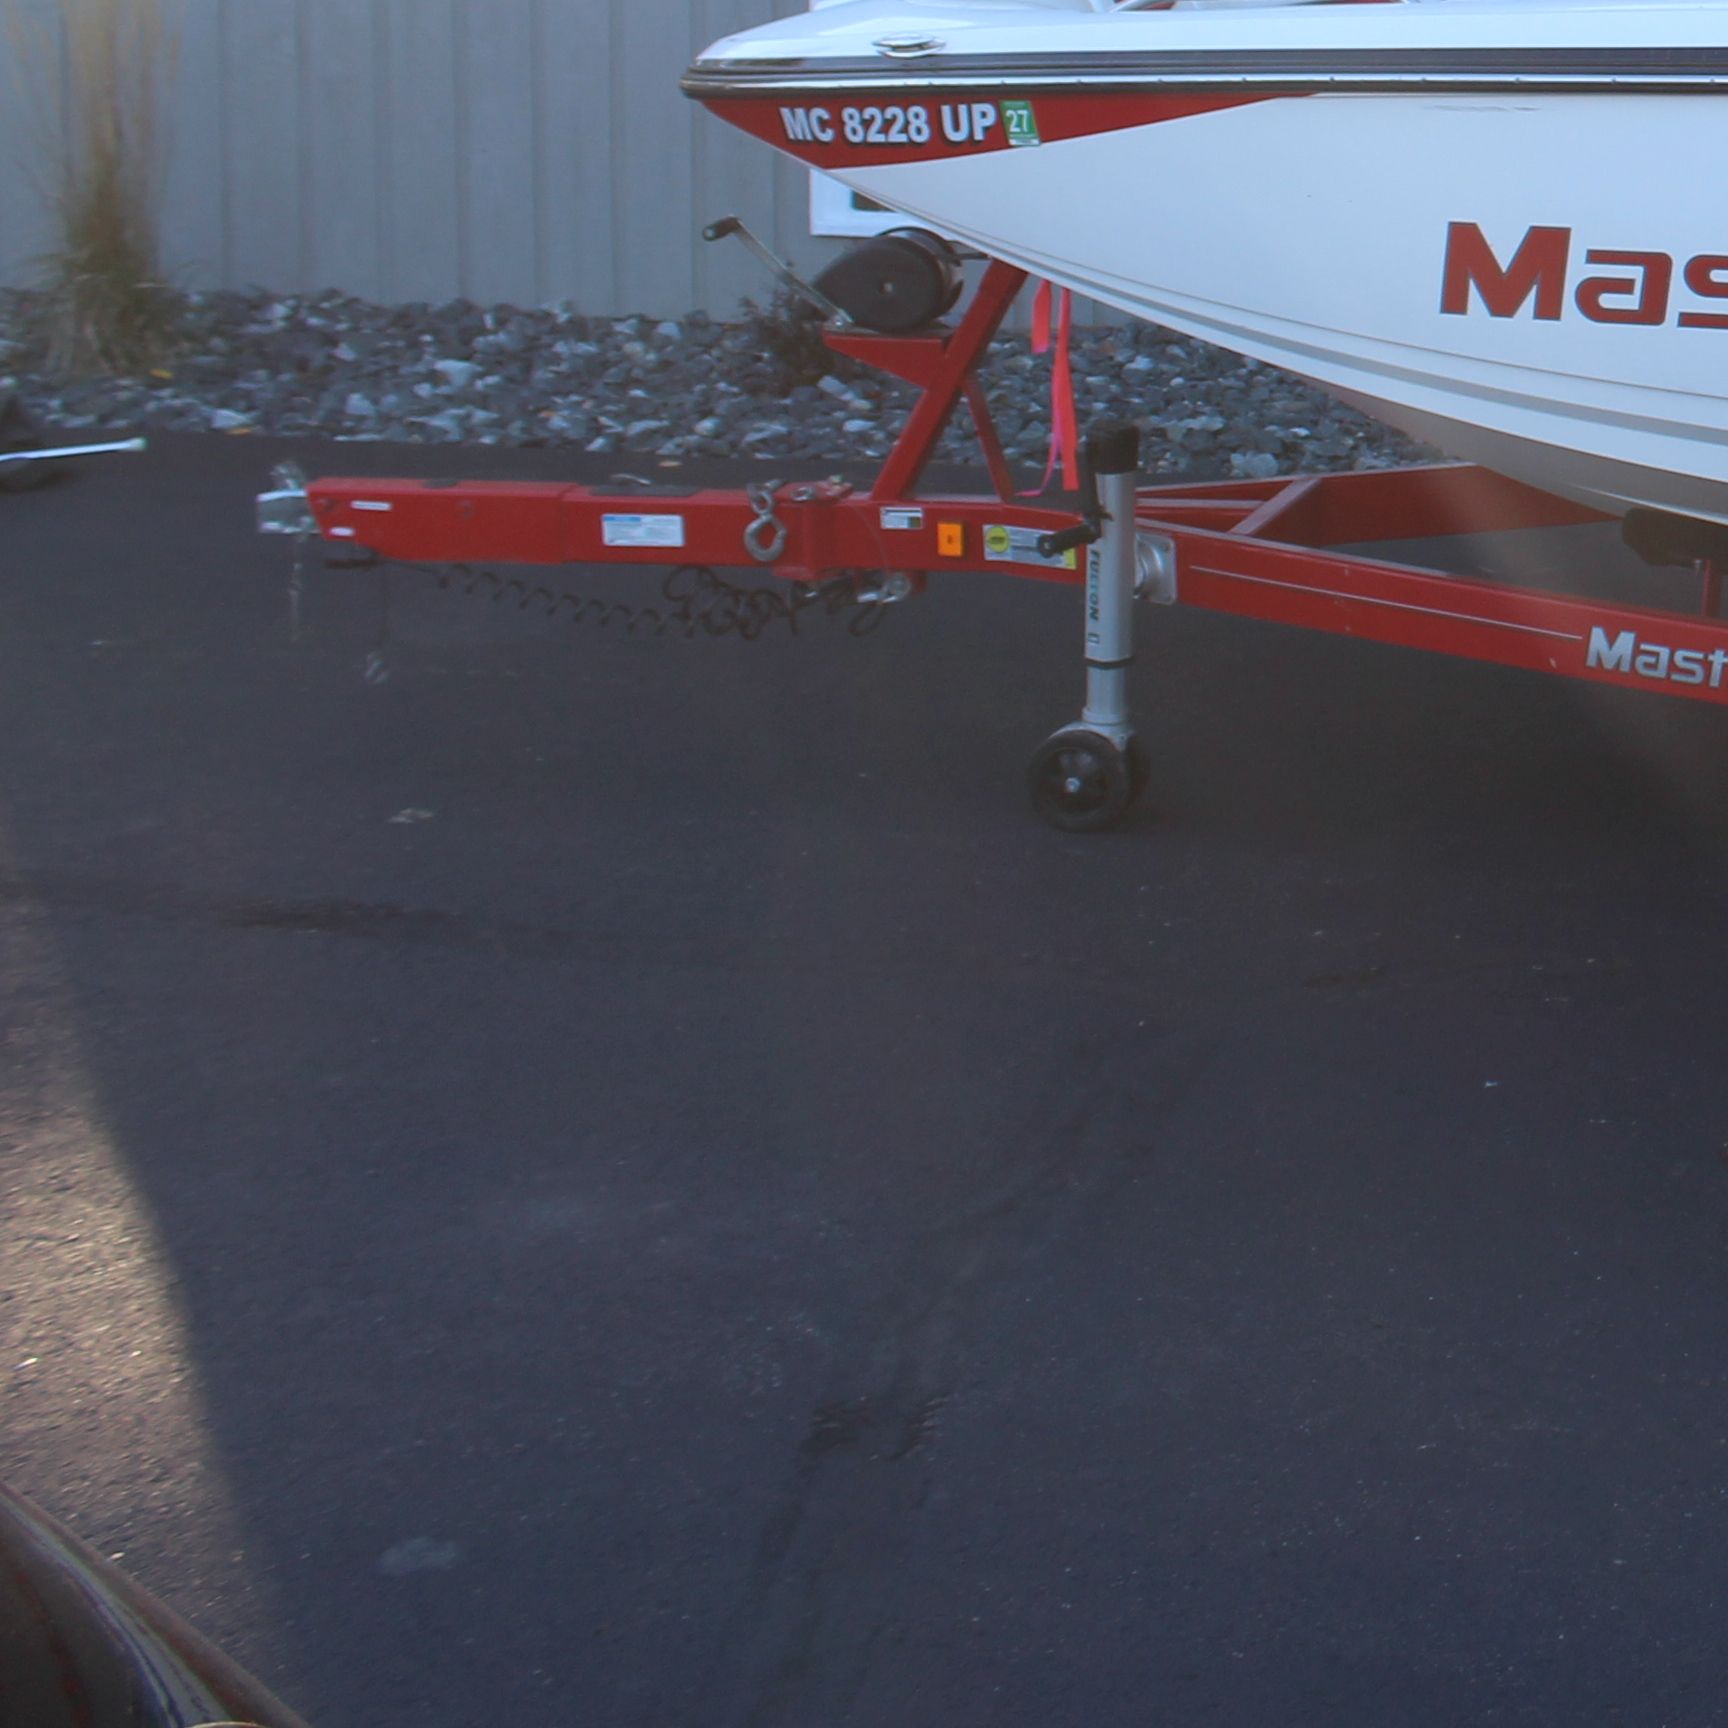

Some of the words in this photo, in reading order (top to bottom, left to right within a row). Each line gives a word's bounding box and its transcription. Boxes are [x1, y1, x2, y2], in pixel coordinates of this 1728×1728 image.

[780, 106, 834, 142] MC
[841, 106, 930, 143] 8228
[940, 103, 996, 142] UP
